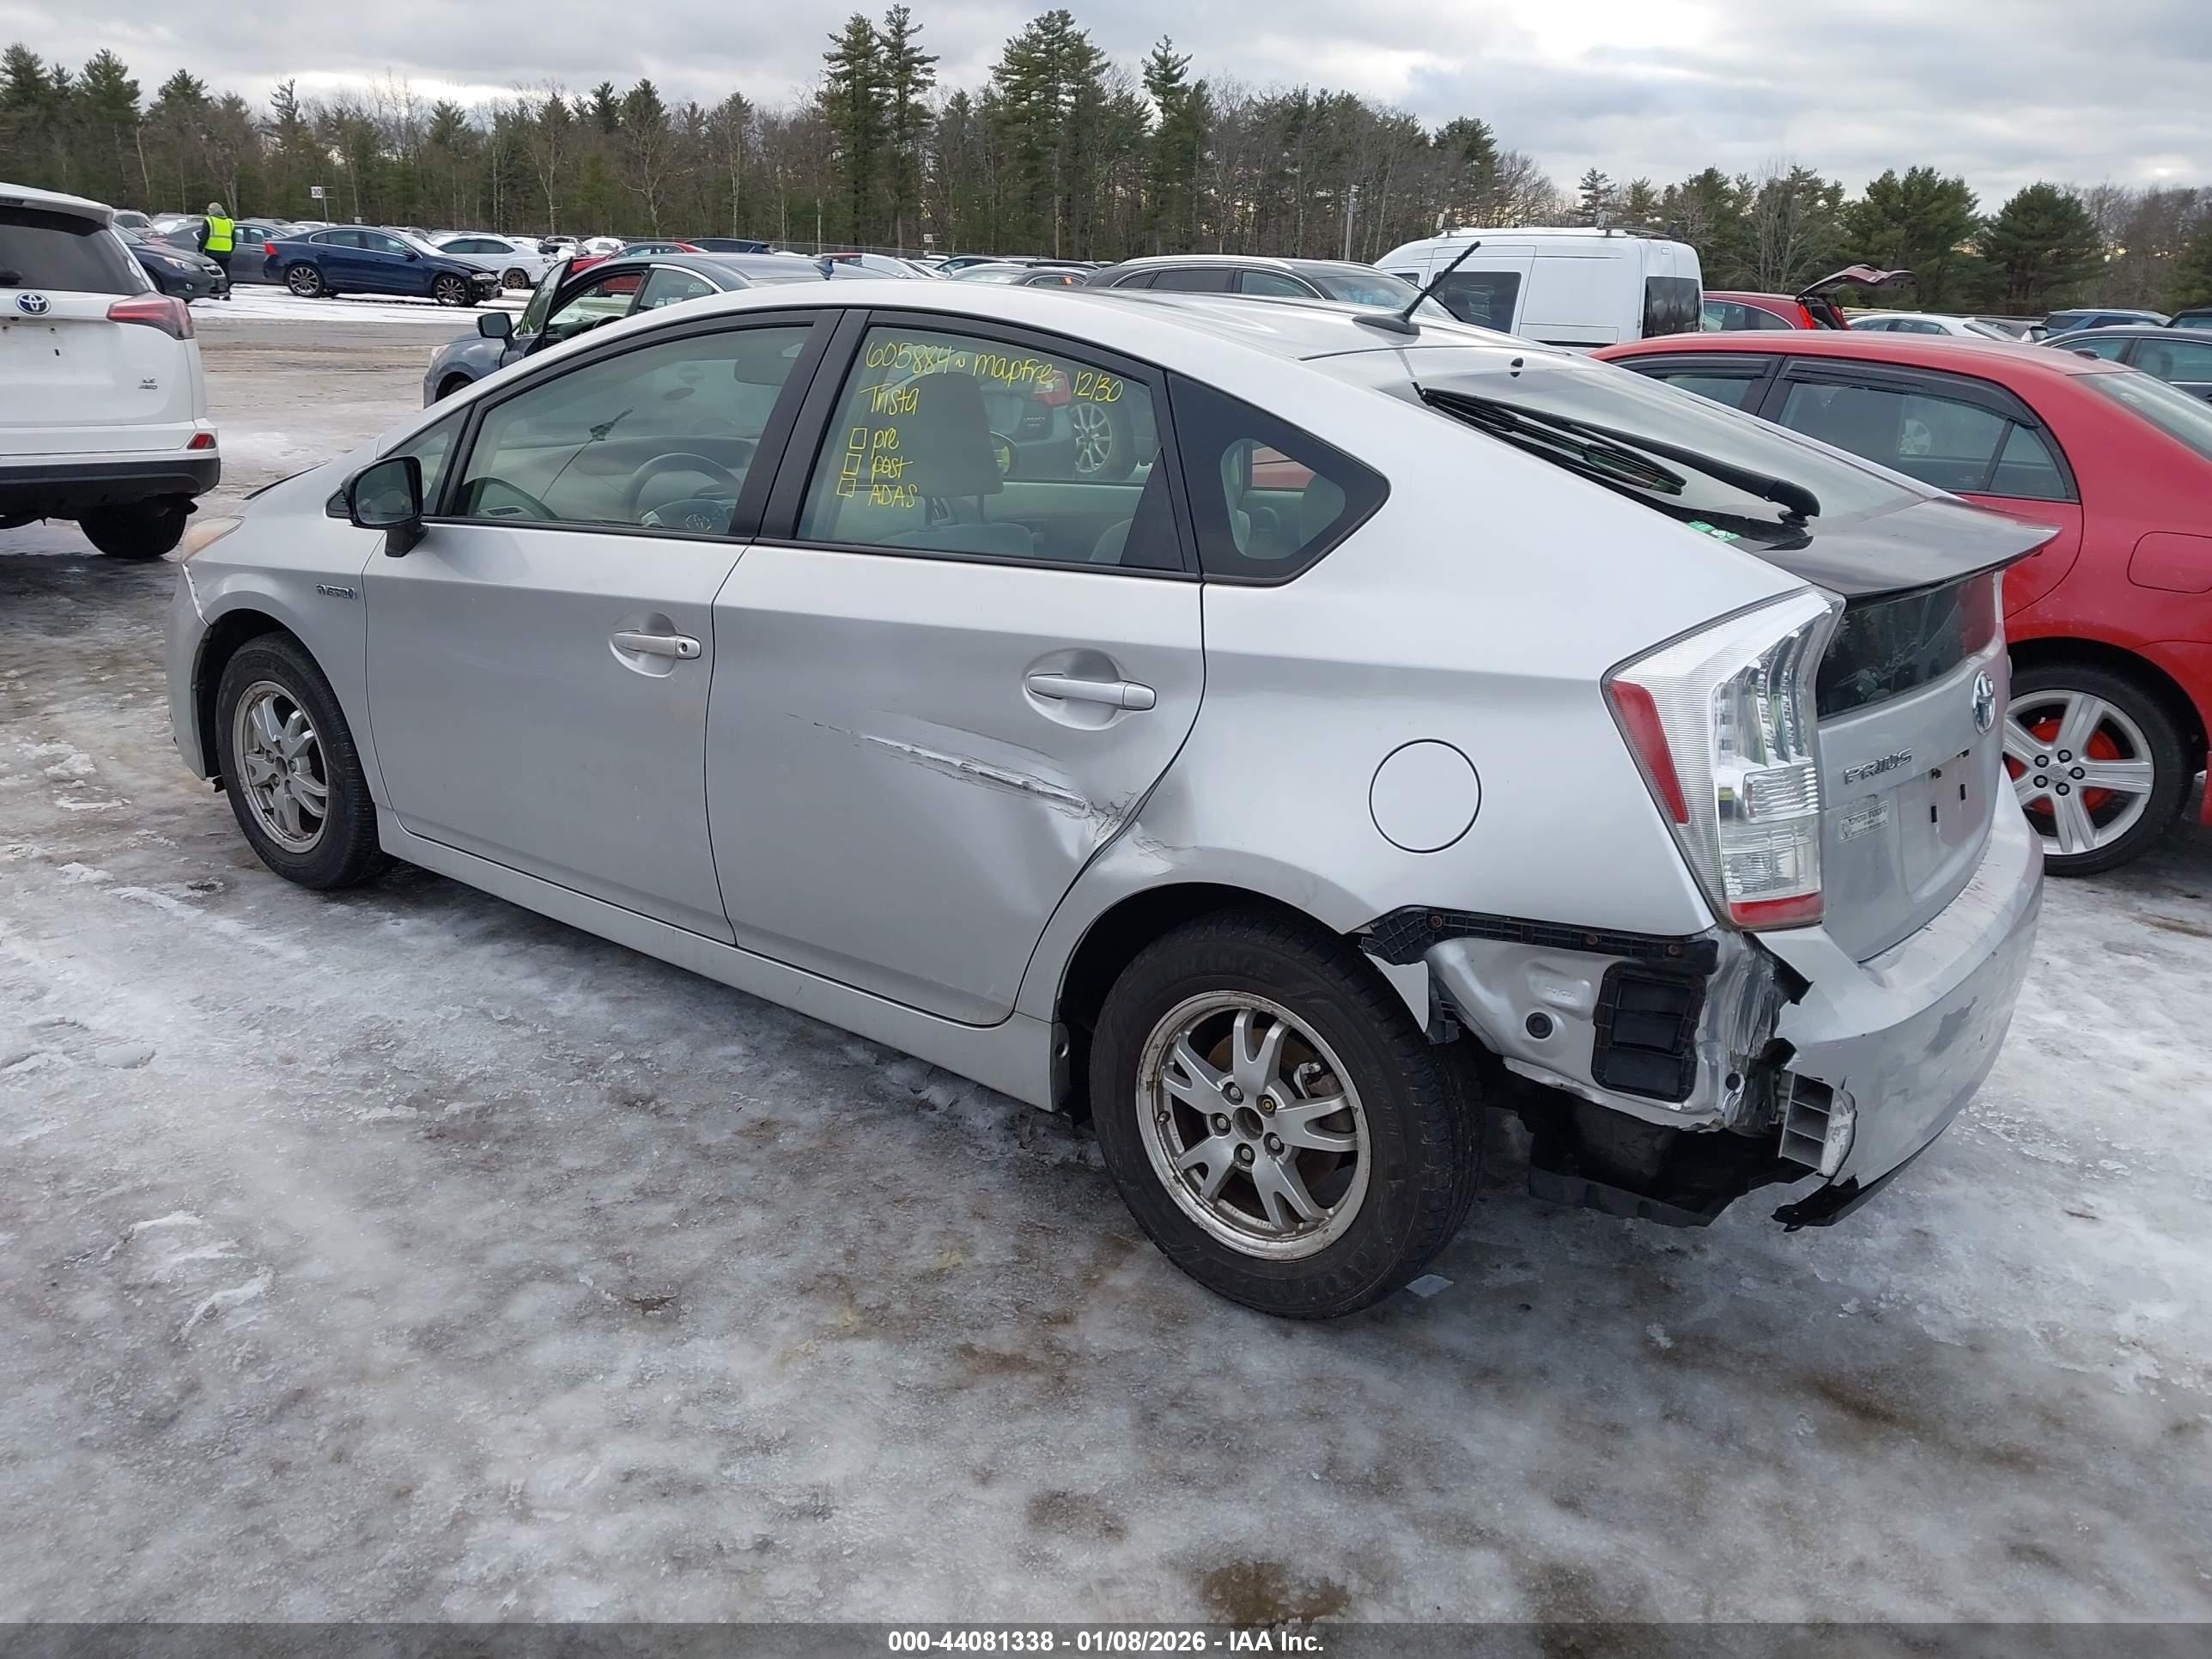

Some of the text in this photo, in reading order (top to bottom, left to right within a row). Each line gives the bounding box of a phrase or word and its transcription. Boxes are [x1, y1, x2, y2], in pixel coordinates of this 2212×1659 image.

[866, 342, 952, 374] 605884
[1073, 370, 1124, 402] 12/30
[860, 383, 920, 416] Trista
[871, 428, 900, 459] pre
[871, 455, 915, 484] post
[868, 484, 918, 508] ADAS
[1843, 748, 1912, 785] PRIUS
